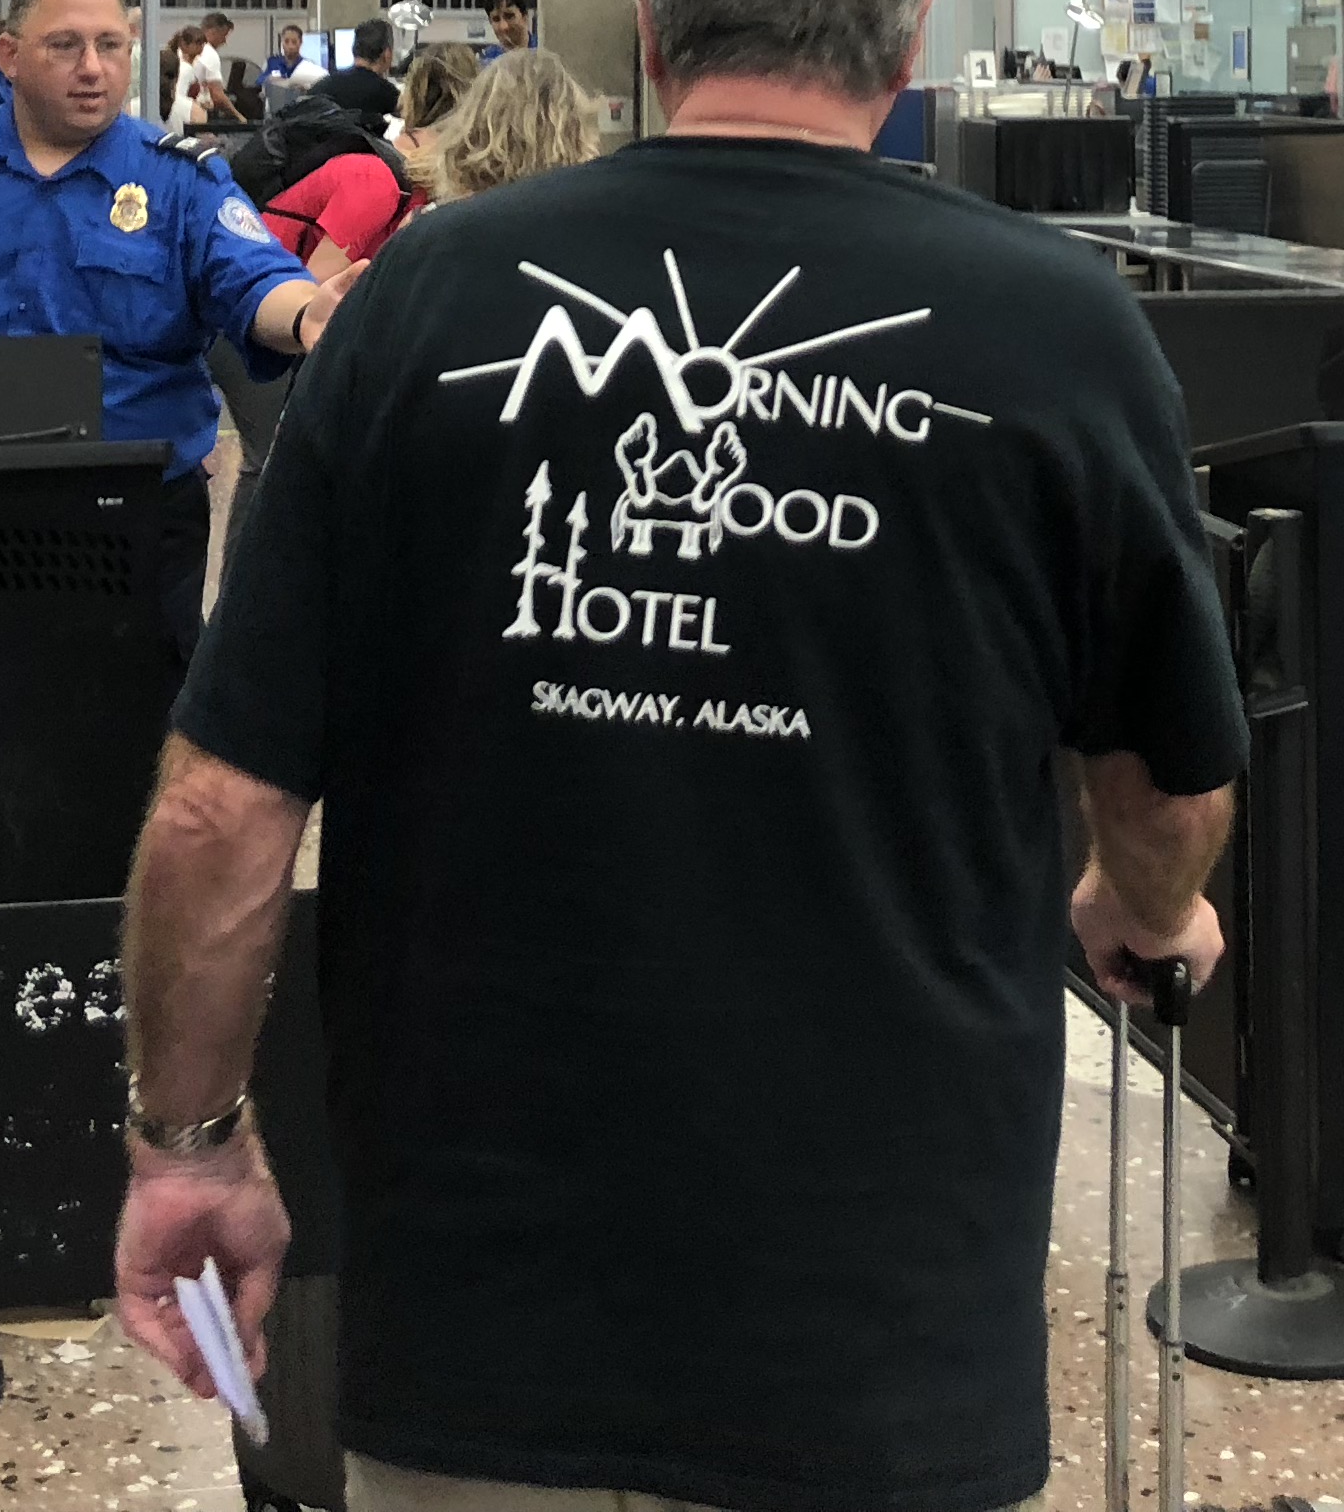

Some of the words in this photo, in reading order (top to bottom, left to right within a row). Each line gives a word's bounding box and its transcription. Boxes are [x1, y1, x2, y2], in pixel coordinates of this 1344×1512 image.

[975, 59, 993, 80] 1
[499, 304, 933, 443] MORNING
[501, 460, 730, 655] HOTEL
[532, 680, 685, 728] SKAGWAY,
[693, 699, 811, 739] ALASKA
